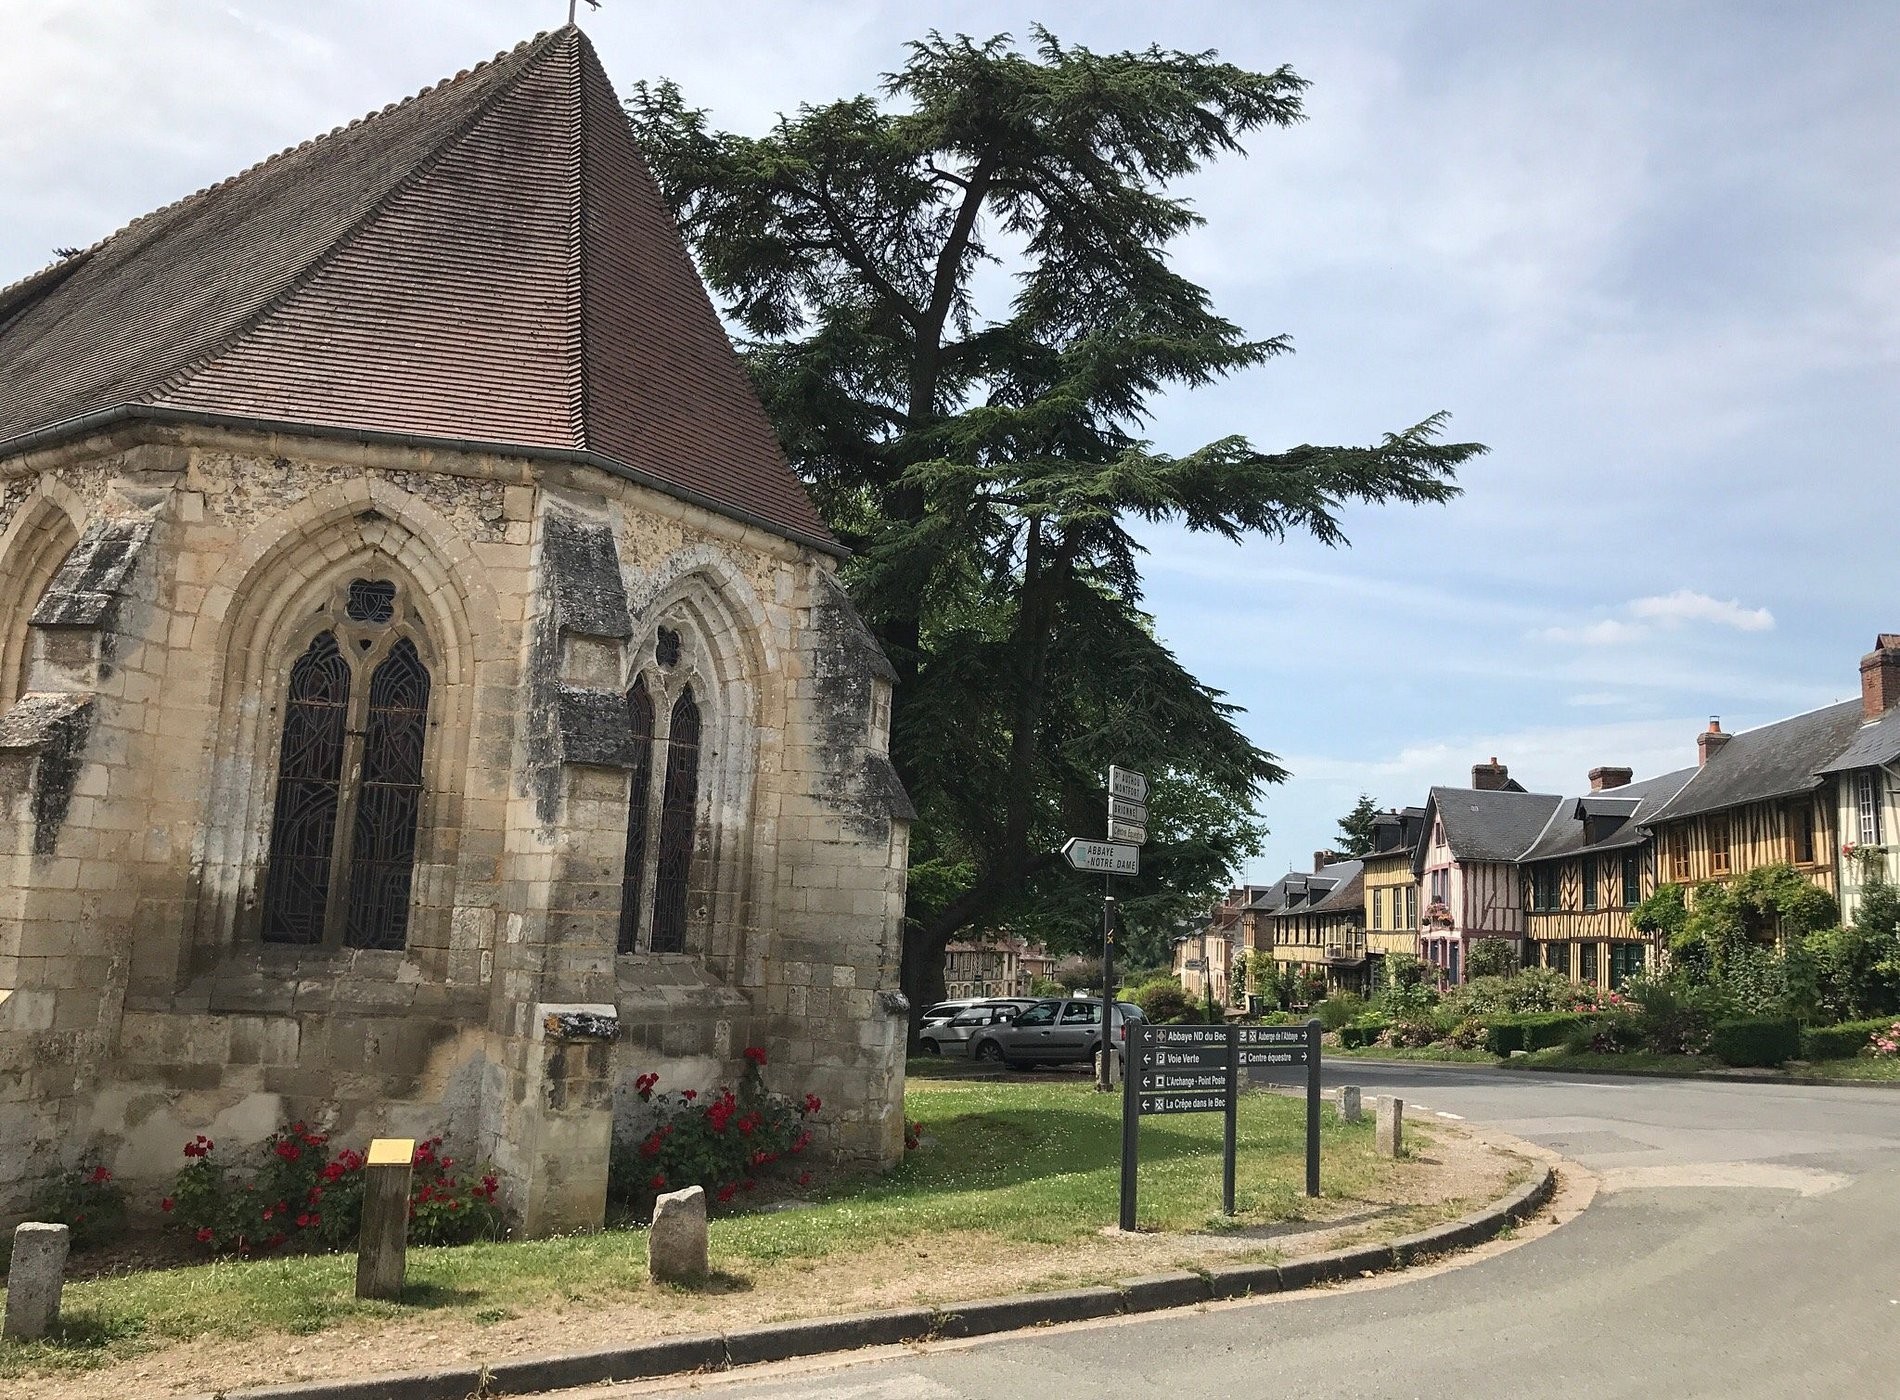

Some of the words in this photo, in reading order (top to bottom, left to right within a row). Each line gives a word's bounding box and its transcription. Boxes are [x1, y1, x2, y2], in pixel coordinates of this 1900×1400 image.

[1114, 782, 1140, 798] MONTFORT
[1114, 804, 1136, 817] BRIONNE
[1088, 846, 1114, 856] ABBAYE
[1116, 860, 1136, 870] DAME
[1168, 1031, 1192, 1043] Abbaye
[1193, 1031, 1204, 1041] ND
[1204, 1031, 1213, 1041] du
[1214, 1031, 1226, 1041] Bec
[1258, 1032, 1275, 1043] Auberge
[1276, 1032, 1280, 1040] de
[1168, 1054, 1182, 1064] Voie
[1182, 1054, 1200, 1064] Verte
[1248, 1052, 1267, 1062] Centre
[1268, 1052, 1292, 1064] équestre
[1166, 1076, 1194, 1088] L'Archange
[1198, 1076, 1211, 1085] Point
[1212, 1075, 1226, 1085] Poste
[1166, 1099, 1174, 1108] La
[1174, 1098, 1192, 1110] Crêpe
[1193, 1098, 1207, 1108] dans
[1208, 1098, 1213, 1107] le
[1214, 1098, 1226, 1107] Bec
